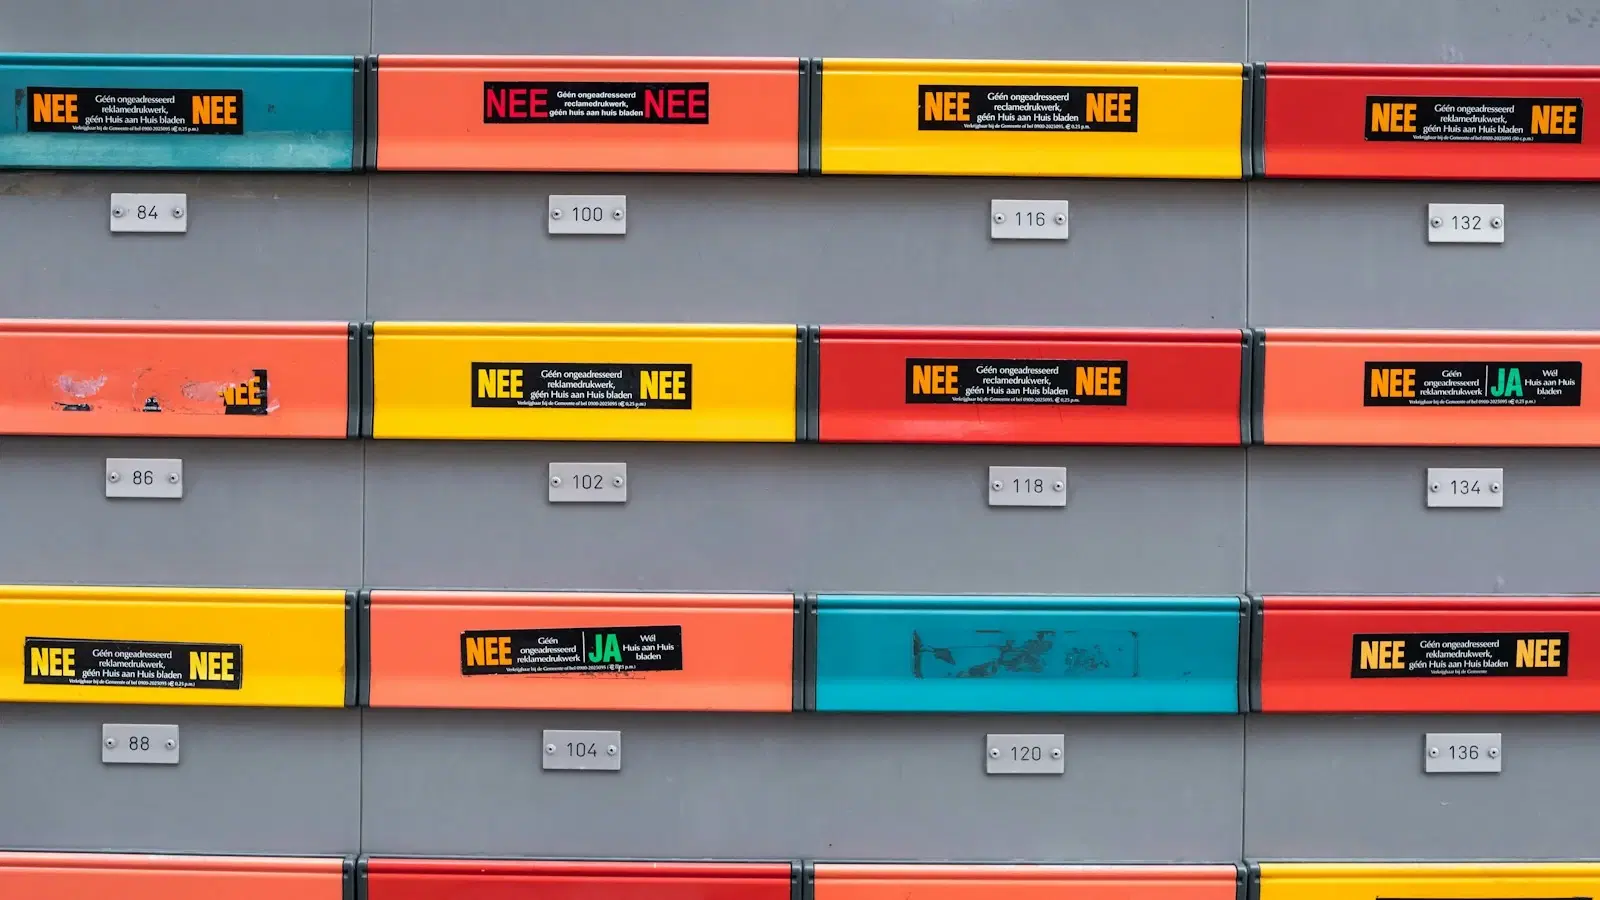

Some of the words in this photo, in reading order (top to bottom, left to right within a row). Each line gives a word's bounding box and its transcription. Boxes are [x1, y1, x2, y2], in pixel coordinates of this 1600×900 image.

[117, 95, 175, 105] ongeadresseerd
[487, 89, 548, 117] NEE
[645, 90, 706, 118] NEE
[1010, 93, 1069, 103] ongeadresseerd
[34, 94, 78, 122] NEE
[102, 105, 168, 114] reklamedrukwerk,
[193, 96, 236, 124] NEE
[549, 109, 567, 117] géén
[925, 92, 970, 120] NEE
[994, 103, 1062, 112] reclamedrukwerk,
[1086, 93, 1130, 122] NEE
[1457, 105, 1514, 114] ongeadresseerd
[85, 116, 103, 125] géén
[160, 116, 185, 124] bladen
[977, 113, 995, 123] géén
[1372, 104, 1416, 132] NEE
[1440, 114, 1507, 124] reklamedrukwerk,
[1532, 106, 1576, 134] NEE
[1423, 125, 1441, 134] géén
[138, 206, 158, 219] 84
[573, 207, 602, 221] 100
[1016, 212, 1044, 226] 116
[1452, 216, 1481, 230] 132
[564, 370, 622, 380] ongeadresseerd
[1000, 366, 1058, 376] ongeadresseerd
[478, 369, 523, 398] NEE
[548, 380, 615, 389] reklamedrukwerk,
[641, 371, 685, 399] NEE
[913, 366, 958, 394] NEE
[983, 376, 1051, 385] reclamedrukwerk,
[1076, 367, 1120, 395] NEE
[1371, 369, 1415, 397] NEE
[1424, 379, 1479, 388] ongeadresseerd
[1491, 368, 1523, 396] JA
[531, 390, 549, 400] géén
[606, 390, 632, 398] bladen
[966, 386, 984, 396] géén
[1042, 387, 1068, 395] bladen
[133, 471, 152, 484] 86
[574, 475, 602, 489] 102
[1014, 479, 1043, 493] 118
[1451, 480, 1480, 494] 134
[466, 637, 512, 666] NEE
[520, 646, 576, 655] ongeadresseerd
[589, 634, 622, 662] JA
[1442, 640, 1499, 650] ongeadresseerd
[114, 650, 172, 660] ongeadresseerd
[517, 654, 580, 663] reklamedrukwerk
[1361, 641, 1405, 669] NEE
[1426, 650, 1492, 658] reklamedrukwerk,
[1516, 640, 1560, 667] NEE
[31, 648, 75, 676] NEE
[99, 659, 165, 669] reklamedrukwerk,
[190, 652, 234, 680] NEE
[1409, 661, 1427, 670] géén
[82, 669, 100, 678] géén
[157, 670, 182, 678] bladen
[130, 736, 149, 750] 88
[568, 743, 596, 757] 104
[1012, 747, 1041, 761] 120
[1450, 746, 1478, 759] 136
